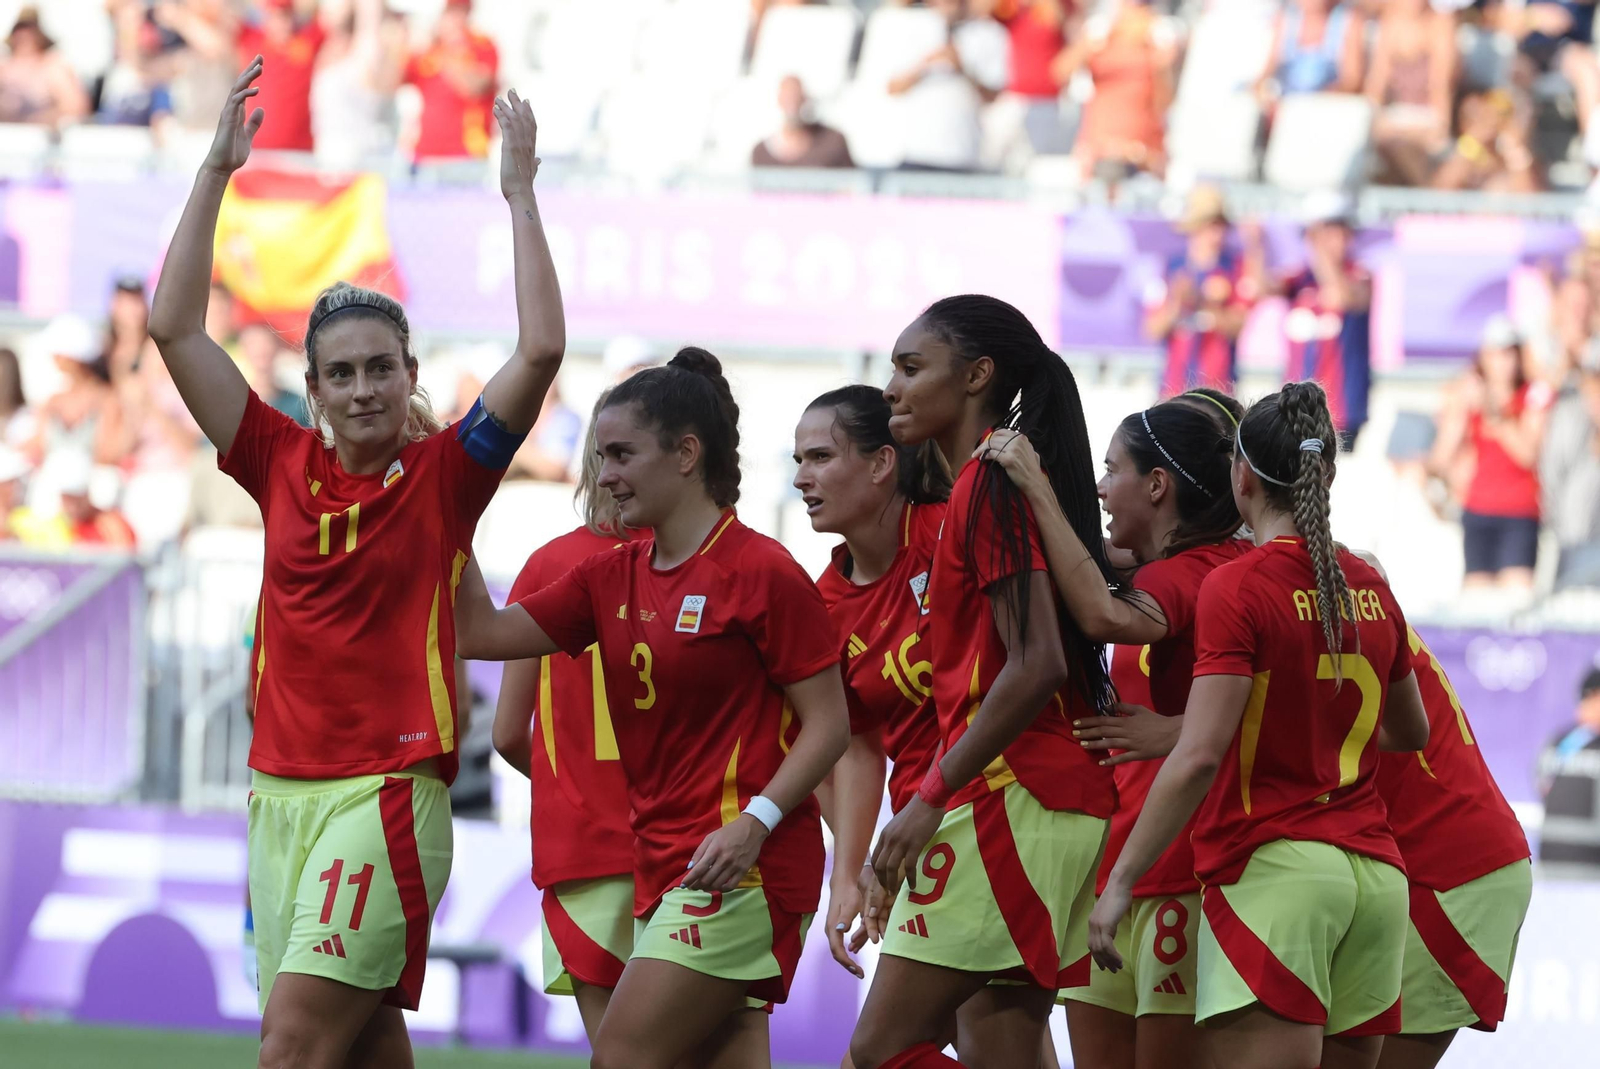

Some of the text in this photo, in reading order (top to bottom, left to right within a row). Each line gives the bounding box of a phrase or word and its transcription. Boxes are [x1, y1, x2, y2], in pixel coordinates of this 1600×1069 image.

[741, 228, 962, 309] 2024
[1293, 589, 1386, 621] ATNEA
[630, 642, 656, 710] 3
[881, 631, 934, 706] 16
[1316, 653, 1382, 788] 7
[319, 858, 375, 931] 11
[907, 842, 957, 906] 9
[1153, 898, 1189, 966] 8
